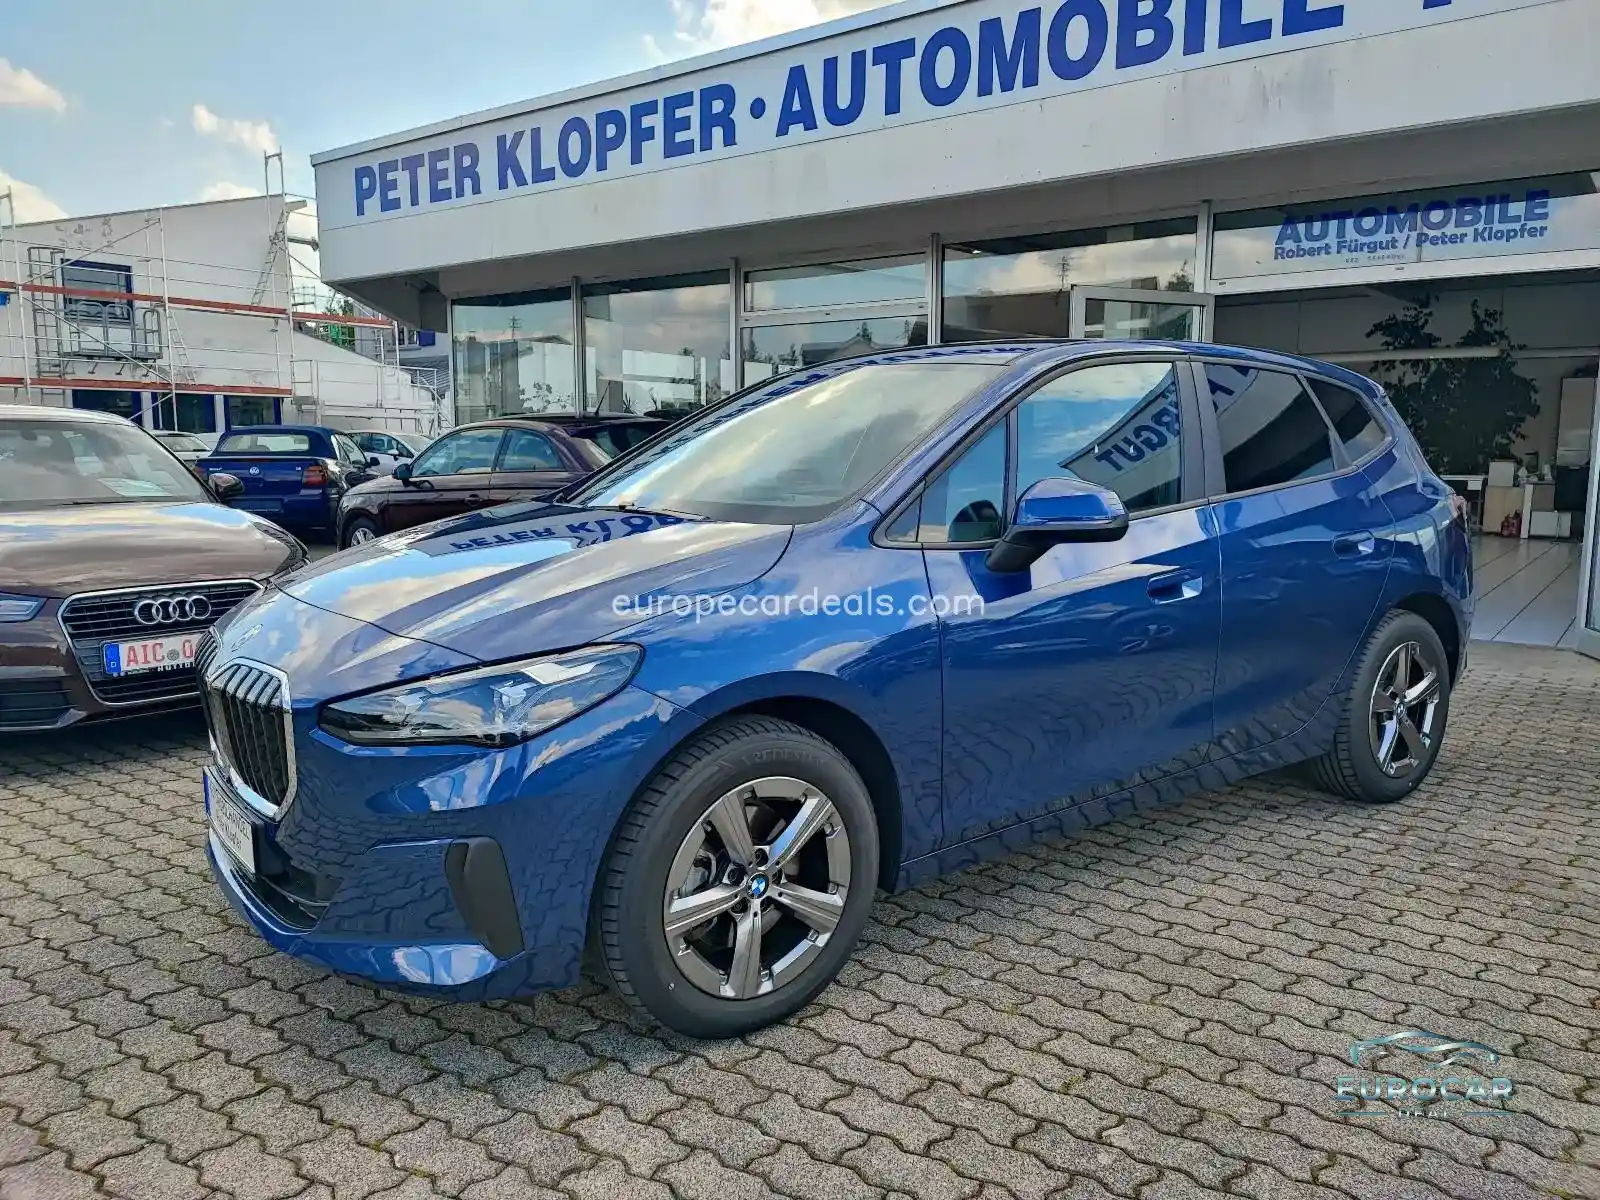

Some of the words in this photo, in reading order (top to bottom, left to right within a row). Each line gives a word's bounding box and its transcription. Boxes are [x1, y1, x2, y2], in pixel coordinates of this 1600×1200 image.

[355, 142, 481, 217] PETER
[497, 83, 738, 191] KLOPFER
[1275, 189, 1550, 245] AUTOMOBILE
[1274, 240, 1331, 260] Robert
[1336, 238, 1399, 255] Fürgut
[1416, 230, 1467, 248] Peter
[1473, 223, 1548, 244] Klopfer
[126, 643, 165, 667] AIC
